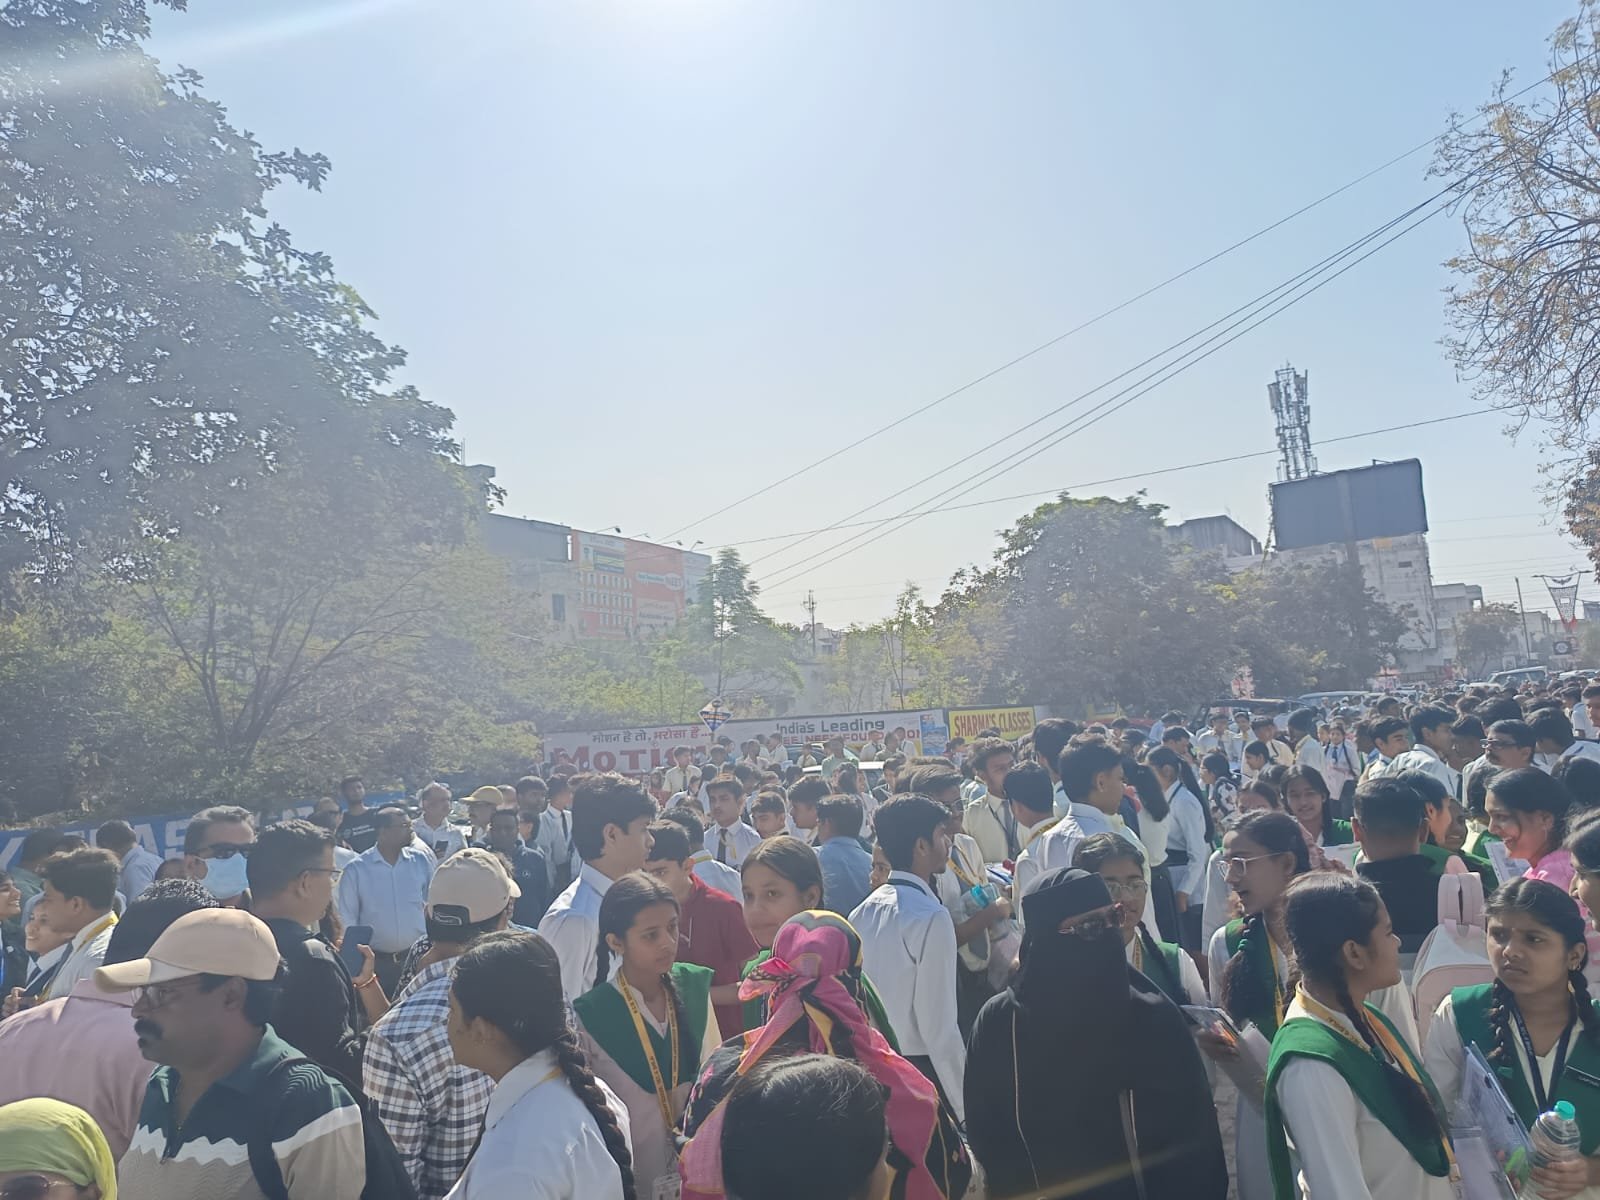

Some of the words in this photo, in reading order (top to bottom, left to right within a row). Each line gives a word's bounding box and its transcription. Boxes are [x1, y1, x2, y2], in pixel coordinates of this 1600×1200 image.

[776, 721, 815, 735] India's
[821, 718, 885, 732] Leading
[954, 714, 996, 737] SHARMA'S
[999, 711, 1031, 733] CLASSES
[623, 729, 632, 743] है
[654, 728, 686, 741] भरोसा
